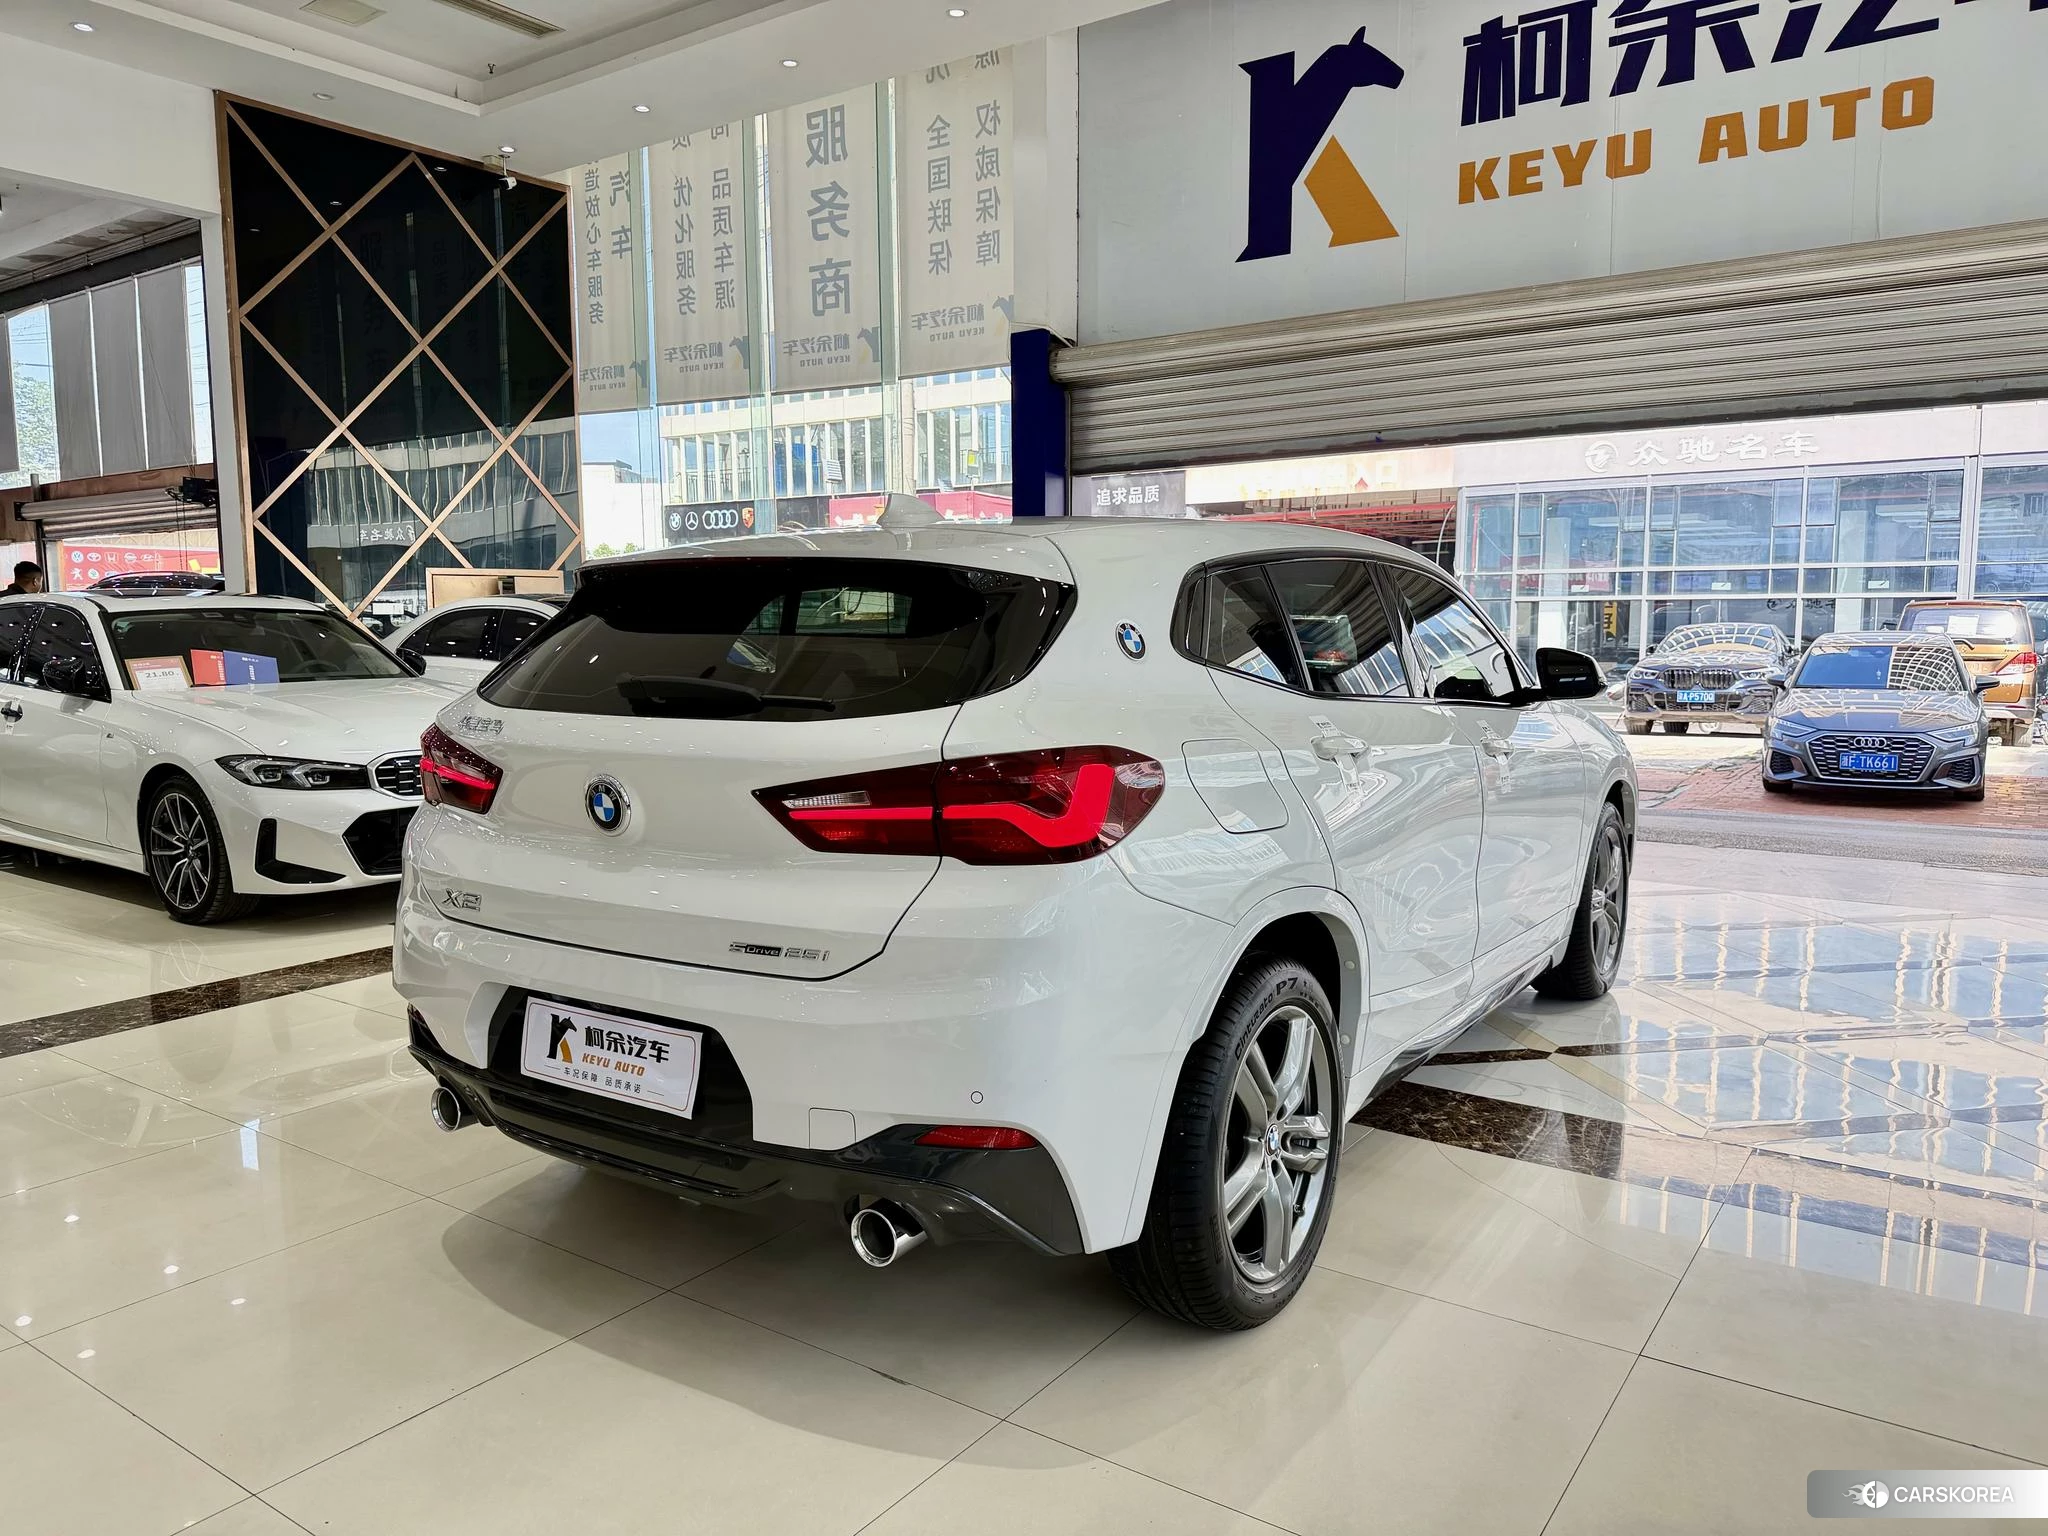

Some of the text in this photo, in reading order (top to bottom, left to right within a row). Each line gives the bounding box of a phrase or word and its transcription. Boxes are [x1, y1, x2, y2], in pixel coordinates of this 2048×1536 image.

[1461, 0, 2048, 126] 柯余
[1459, 76, 1934, 205] KEYU AUTO
[1628, 430, 1820, 466] 众驰名车
[1096, 484, 1159, 506] 追求品质
[441, 888, 482, 911] X2
[784, 947, 830, 961] 25i
[1276, 977, 1298, 996] P7
[584, 1026, 670, 1064] 柯余汽车
[581, 1053, 645, 1077] KEYU AUTO
[563, 1067, 642, 1094] 车况保障 品质承诺
